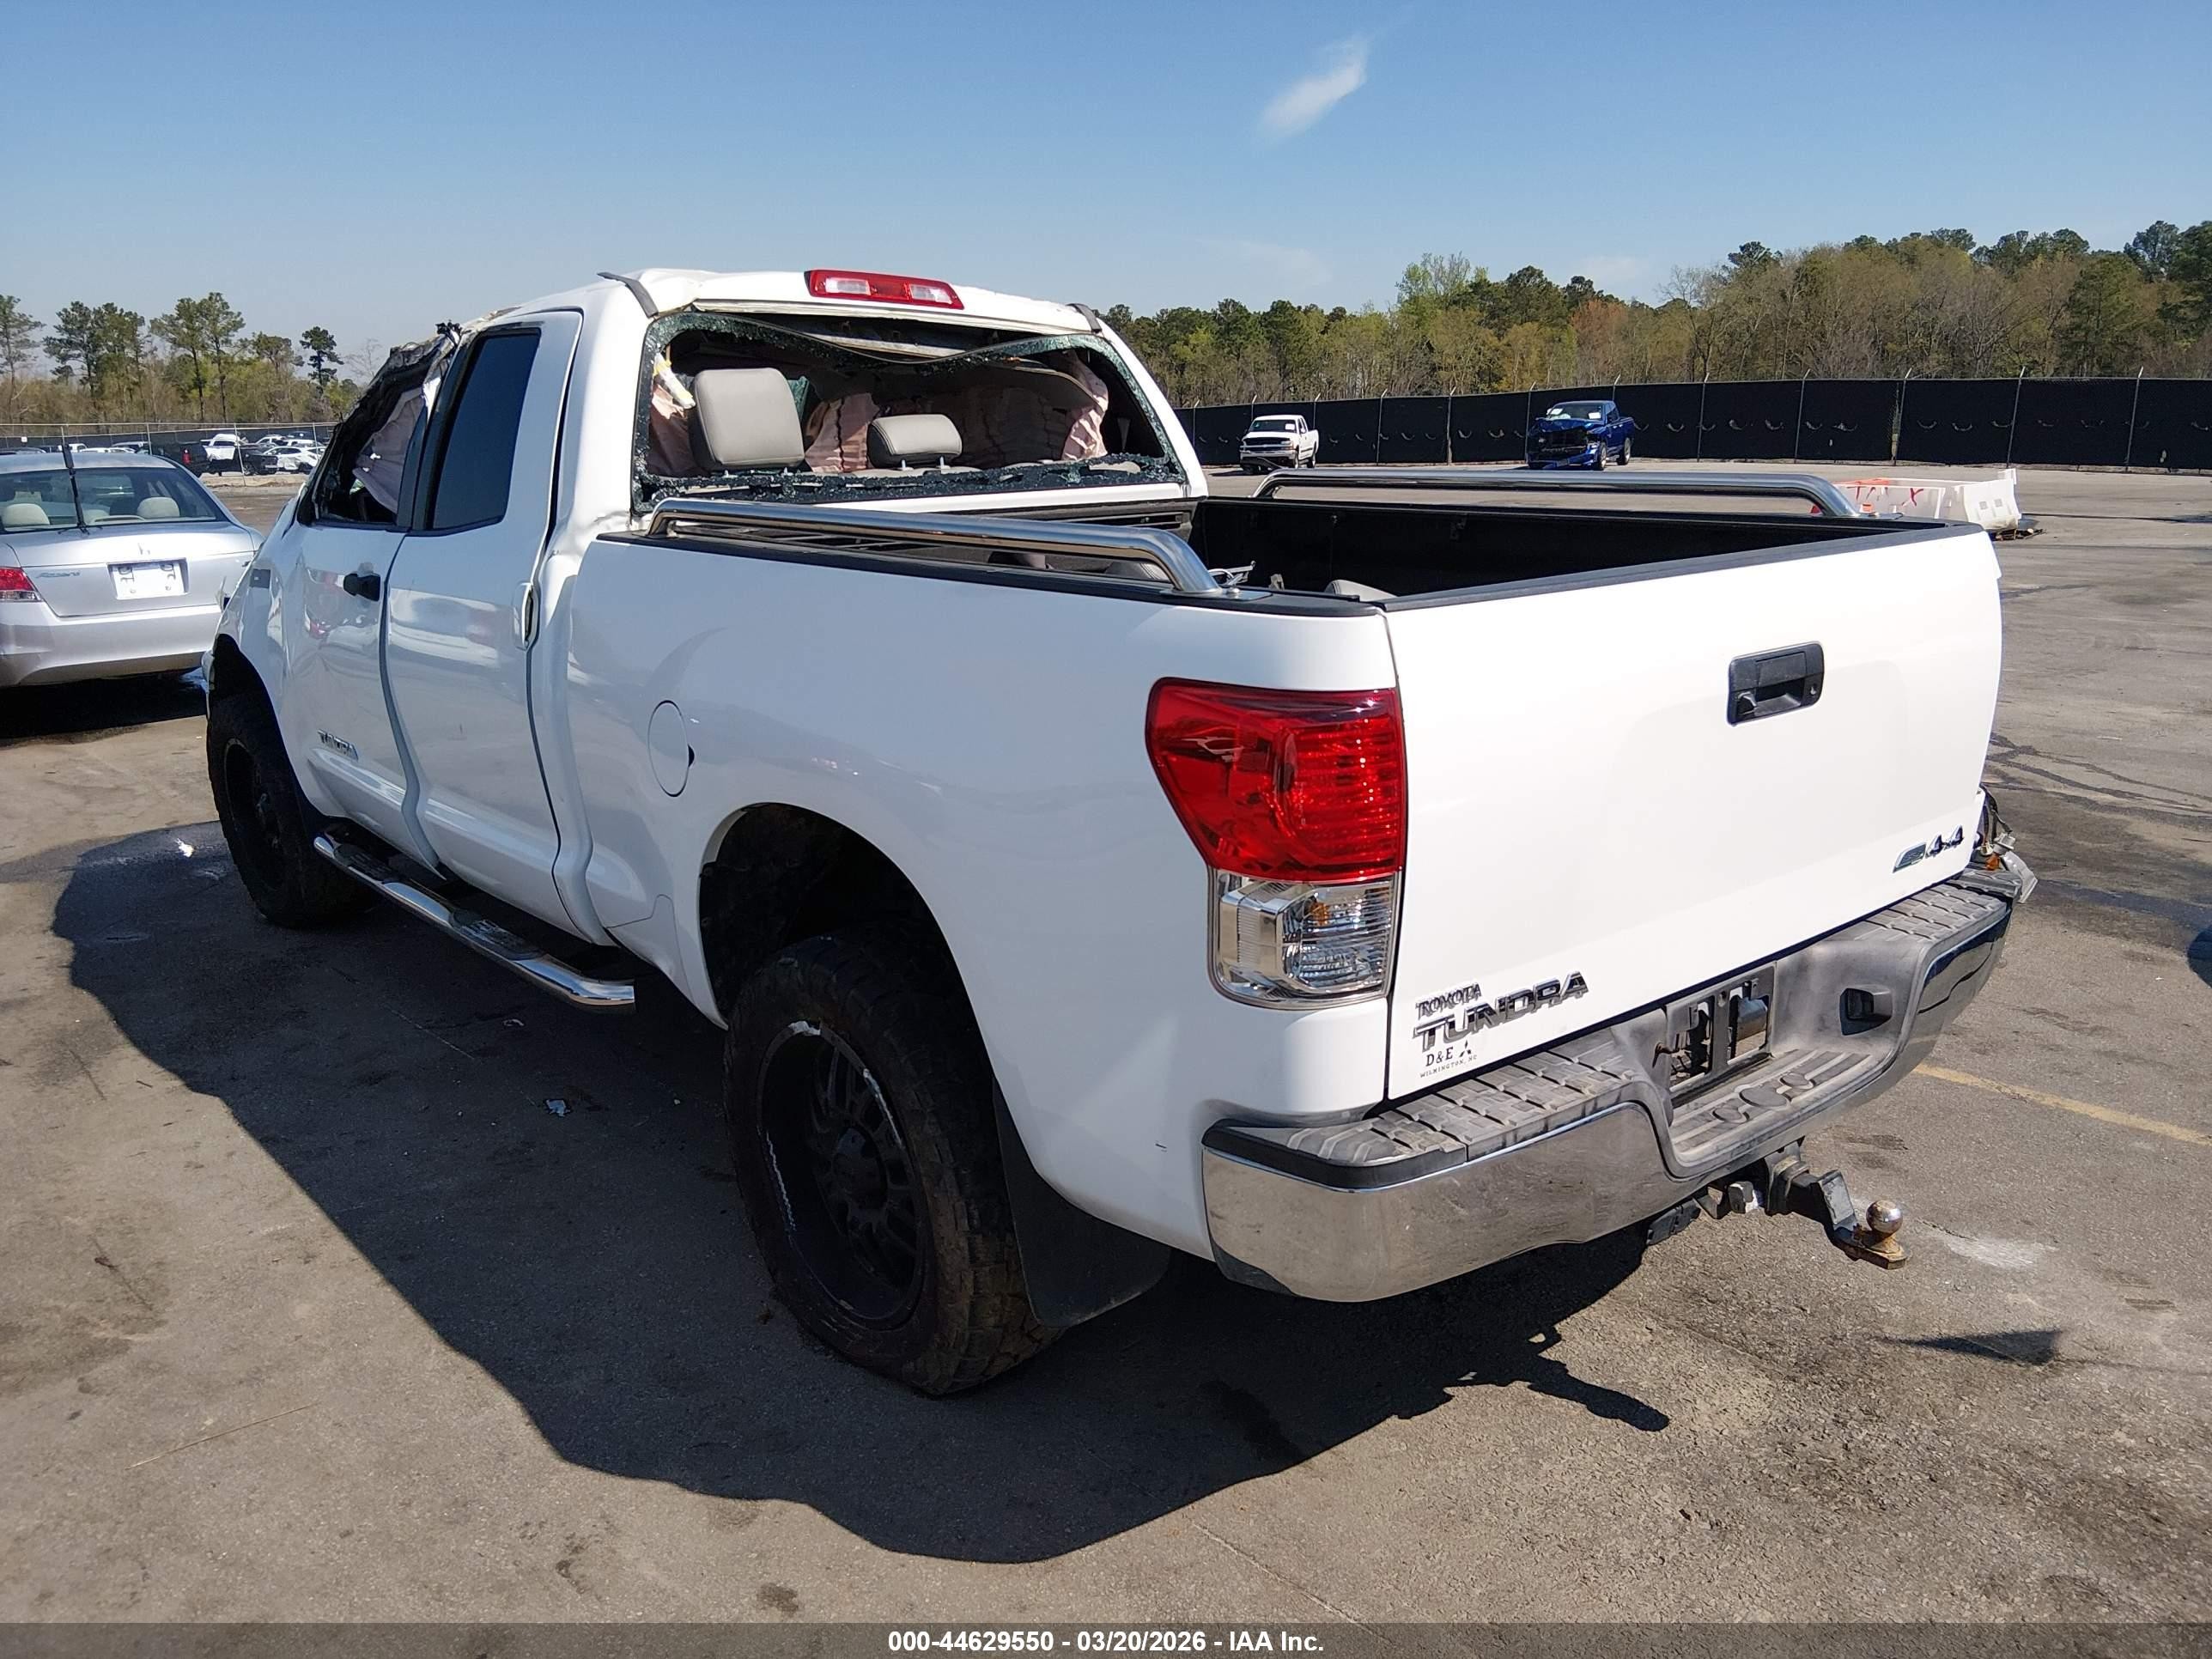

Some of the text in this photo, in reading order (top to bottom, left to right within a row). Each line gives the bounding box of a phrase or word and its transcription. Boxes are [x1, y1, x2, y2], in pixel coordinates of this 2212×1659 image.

[1413, 971, 1589, 1052] TUNDRA
[1416, 982, 1482, 1019] TOYOTA
[1425, 1046, 1454, 1066] D&E
